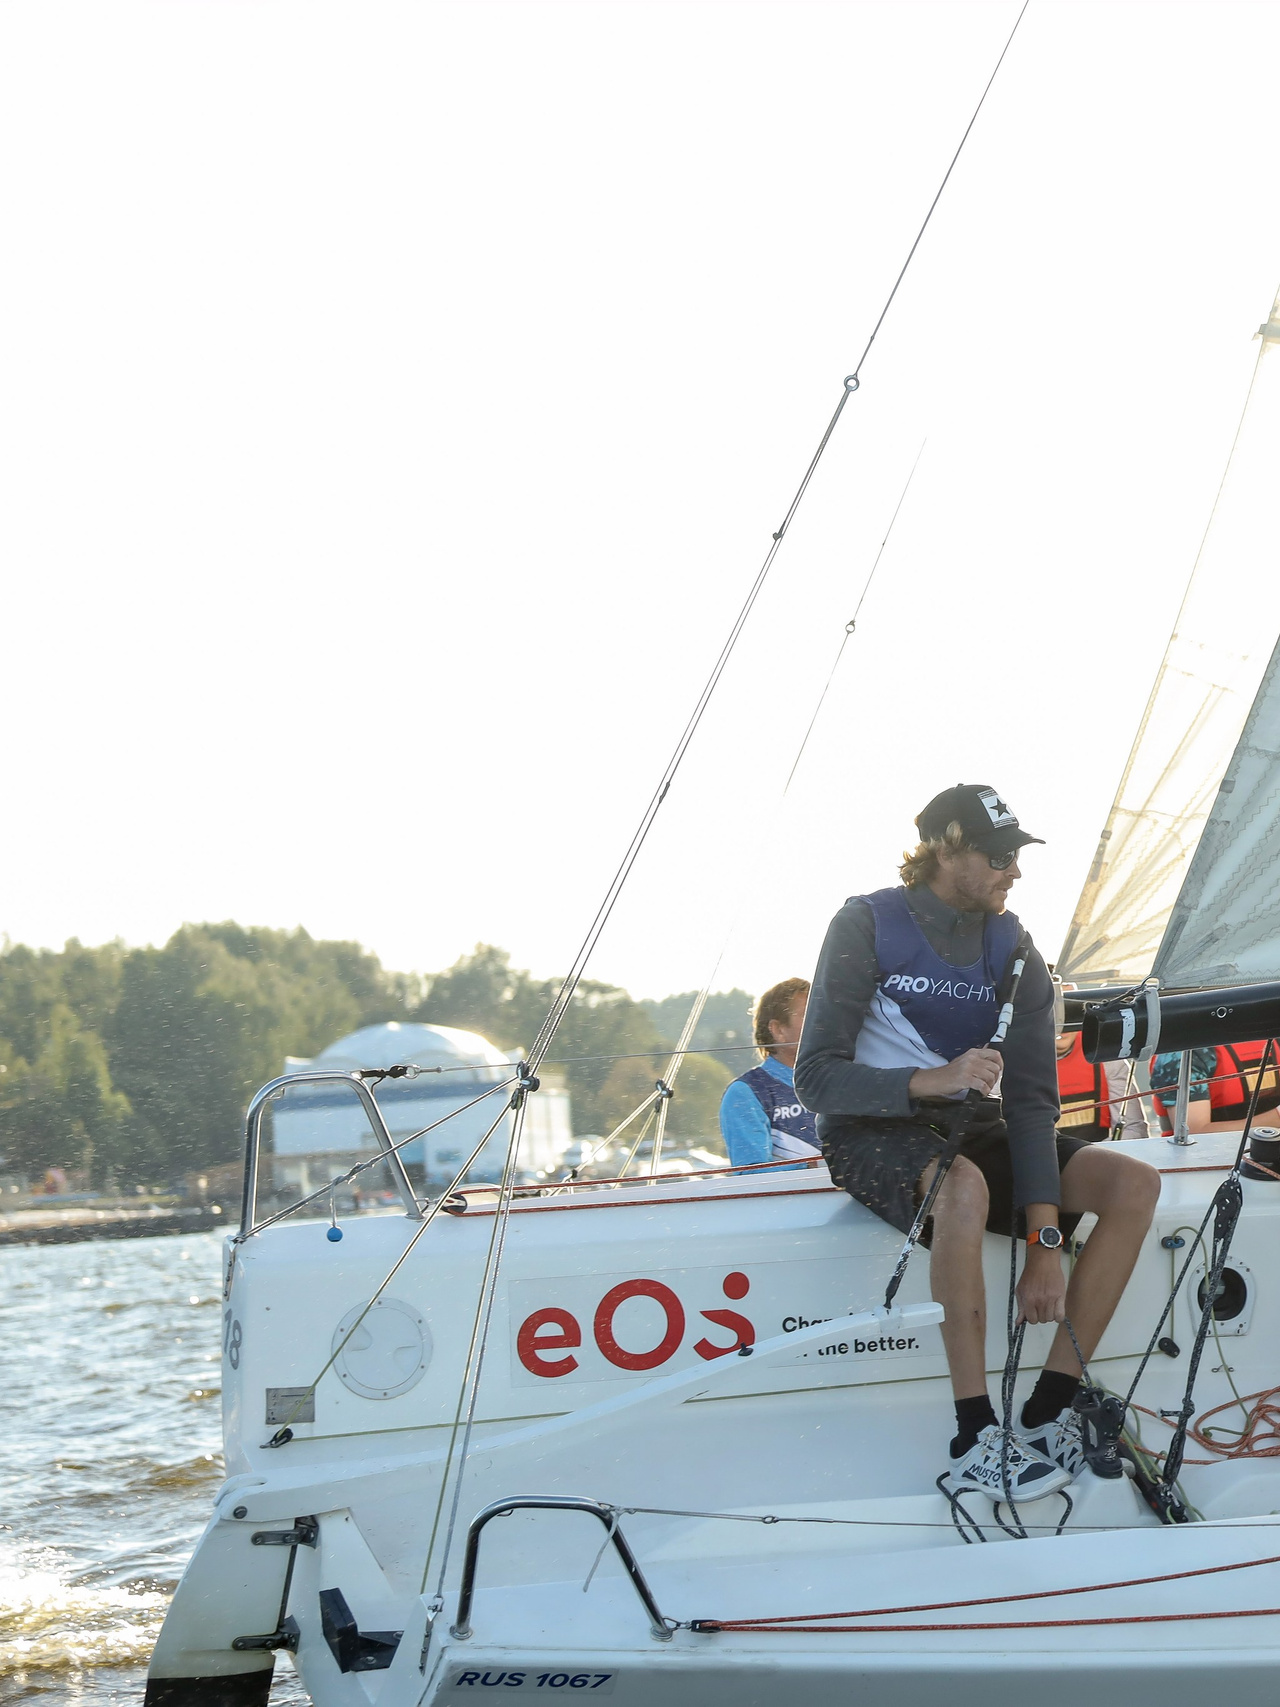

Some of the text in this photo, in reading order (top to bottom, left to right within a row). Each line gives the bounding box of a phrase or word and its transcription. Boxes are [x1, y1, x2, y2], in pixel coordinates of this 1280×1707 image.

[854, 1337, 920, 1354] better.
[968, 1463, 1001, 1483] MUSTO
[456, 1671, 613, 1689] RUS 1067
